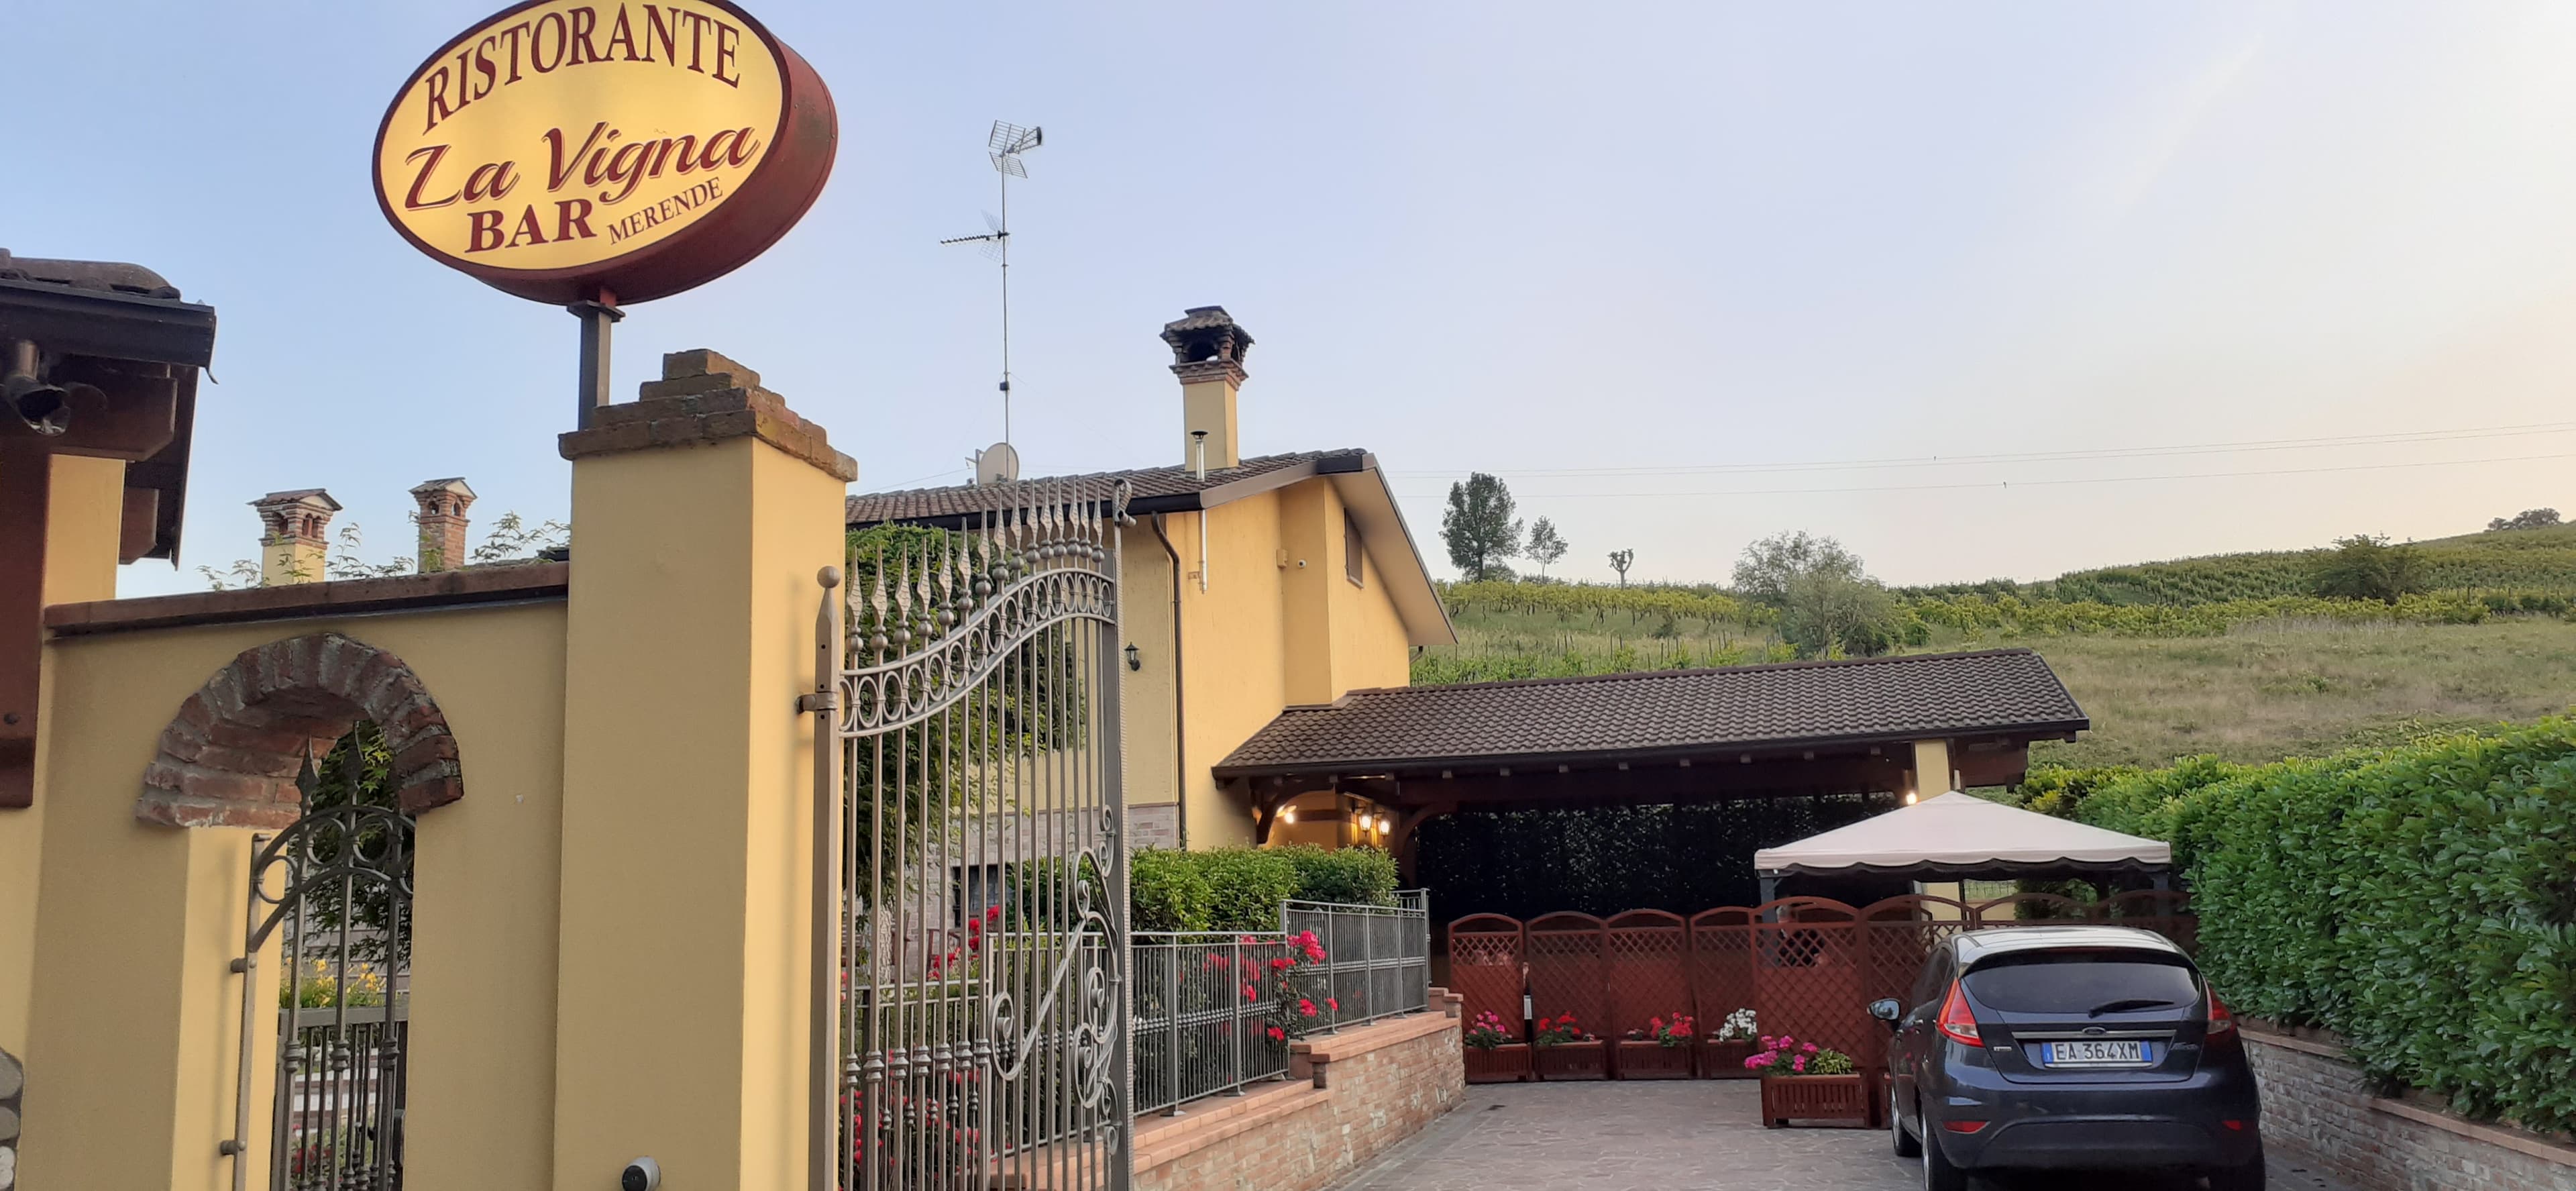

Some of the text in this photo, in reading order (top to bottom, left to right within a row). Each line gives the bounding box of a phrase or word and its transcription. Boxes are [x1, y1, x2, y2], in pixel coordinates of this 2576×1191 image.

[422, 3, 741, 136] RISTORANTE
[541, 121, 761, 203] Vigna
[464, 198, 598, 254] BAR
[606, 176, 724, 246] MERENDE
[2055, 1043, 2078, 1060] EA
[2082, 1043, 2140, 1060] 364XM
